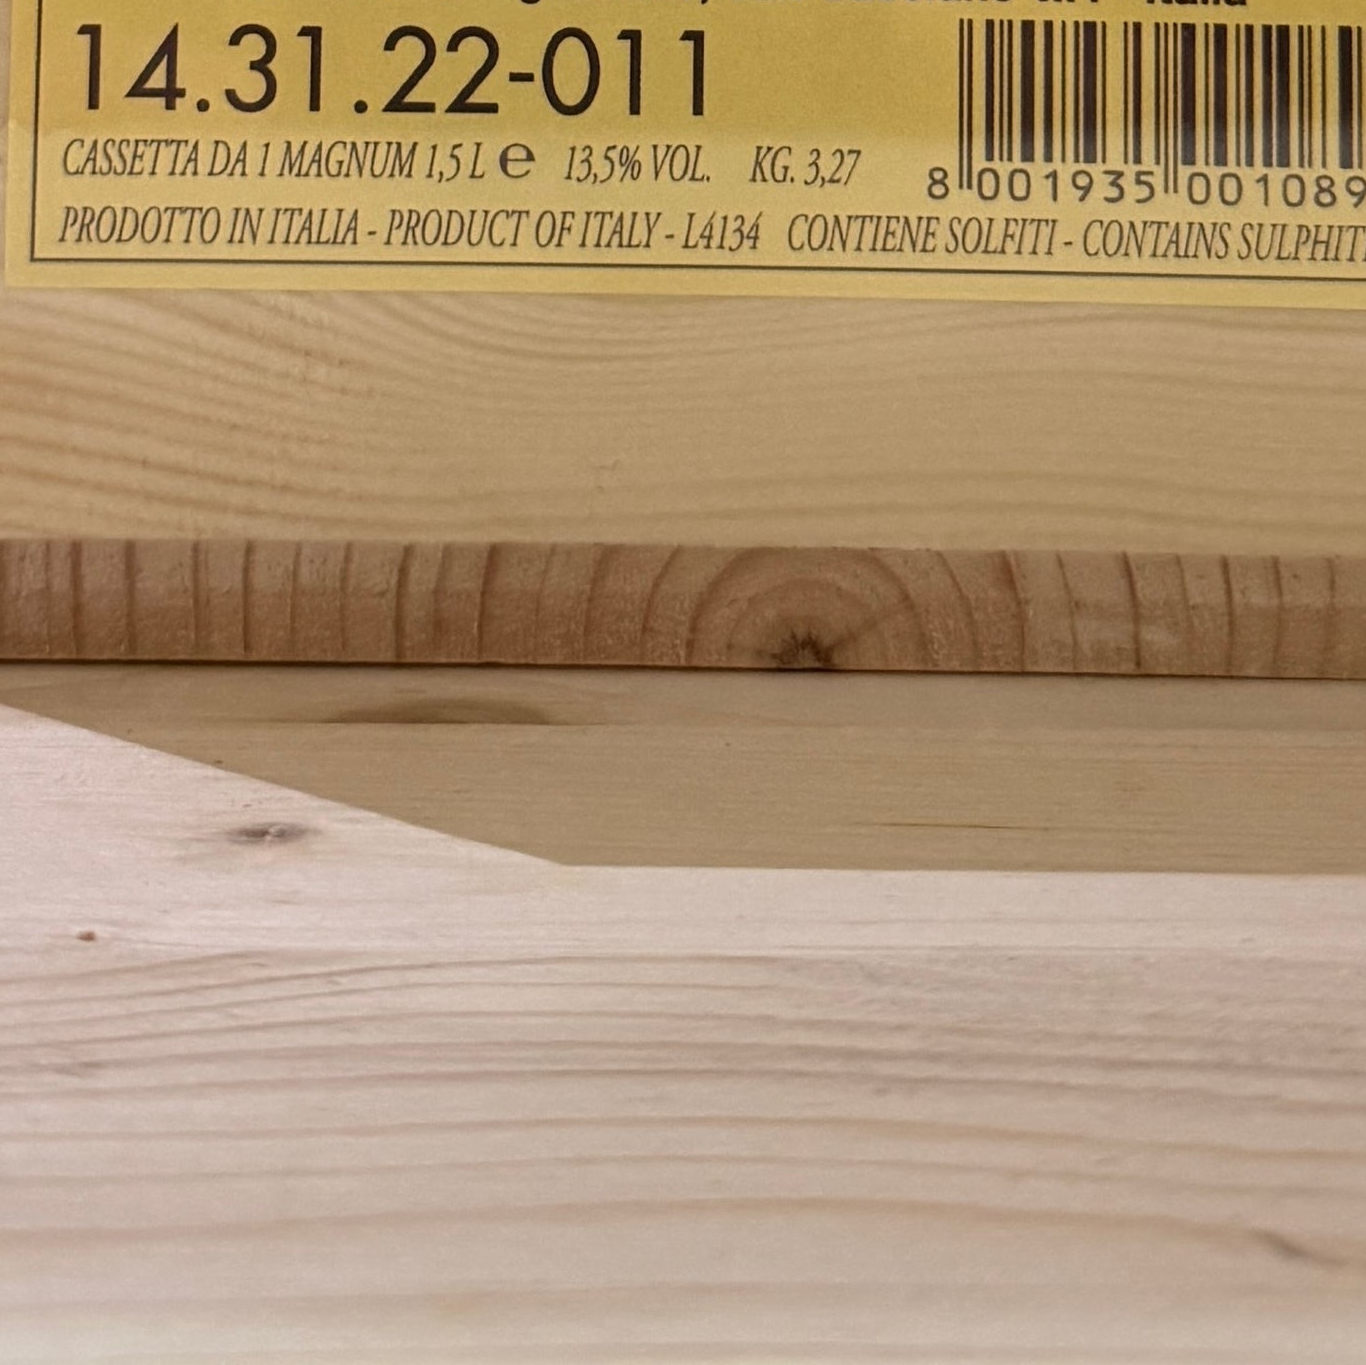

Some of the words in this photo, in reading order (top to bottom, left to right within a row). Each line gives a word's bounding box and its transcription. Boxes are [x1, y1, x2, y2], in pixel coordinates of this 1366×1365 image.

[76, 22, 705, 117] 14.31.22-011
[62, 138, 200, 177] CASSETTA
[206, 139, 248, 178] DA
[257, 141, 271, 178] 1
[281, 140, 419, 179] MAGNUM
[425, 142, 464, 184] 1,5
[468, 141, 486, 180] L
[564, 144, 642, 185] 13,5%
[651, 143, 711, 183] VOL.
[748, 145, 795, 184] KG.
[803, 148, 862, 189] 3,27
[927, 166, 950, 201] 8
[976, 167, 1156, 204] 001935
[58, 205, 222, 245] PRODOTTO
[226, 207, 265, 246] IN
[268, 207, 360, 247] ITALIA
[383, 208, 531, 248] PRODUCT
[534, 209, 576, 249] OF
[578, 210, 663, 249] ITALY
[681, 210, 763, 253] L4134
[787, 213, 941, 254] CONTIENE
[944, 216, 1059, 256] SOLFITI
[1082, 219, 1232, 260] CONTAINS
